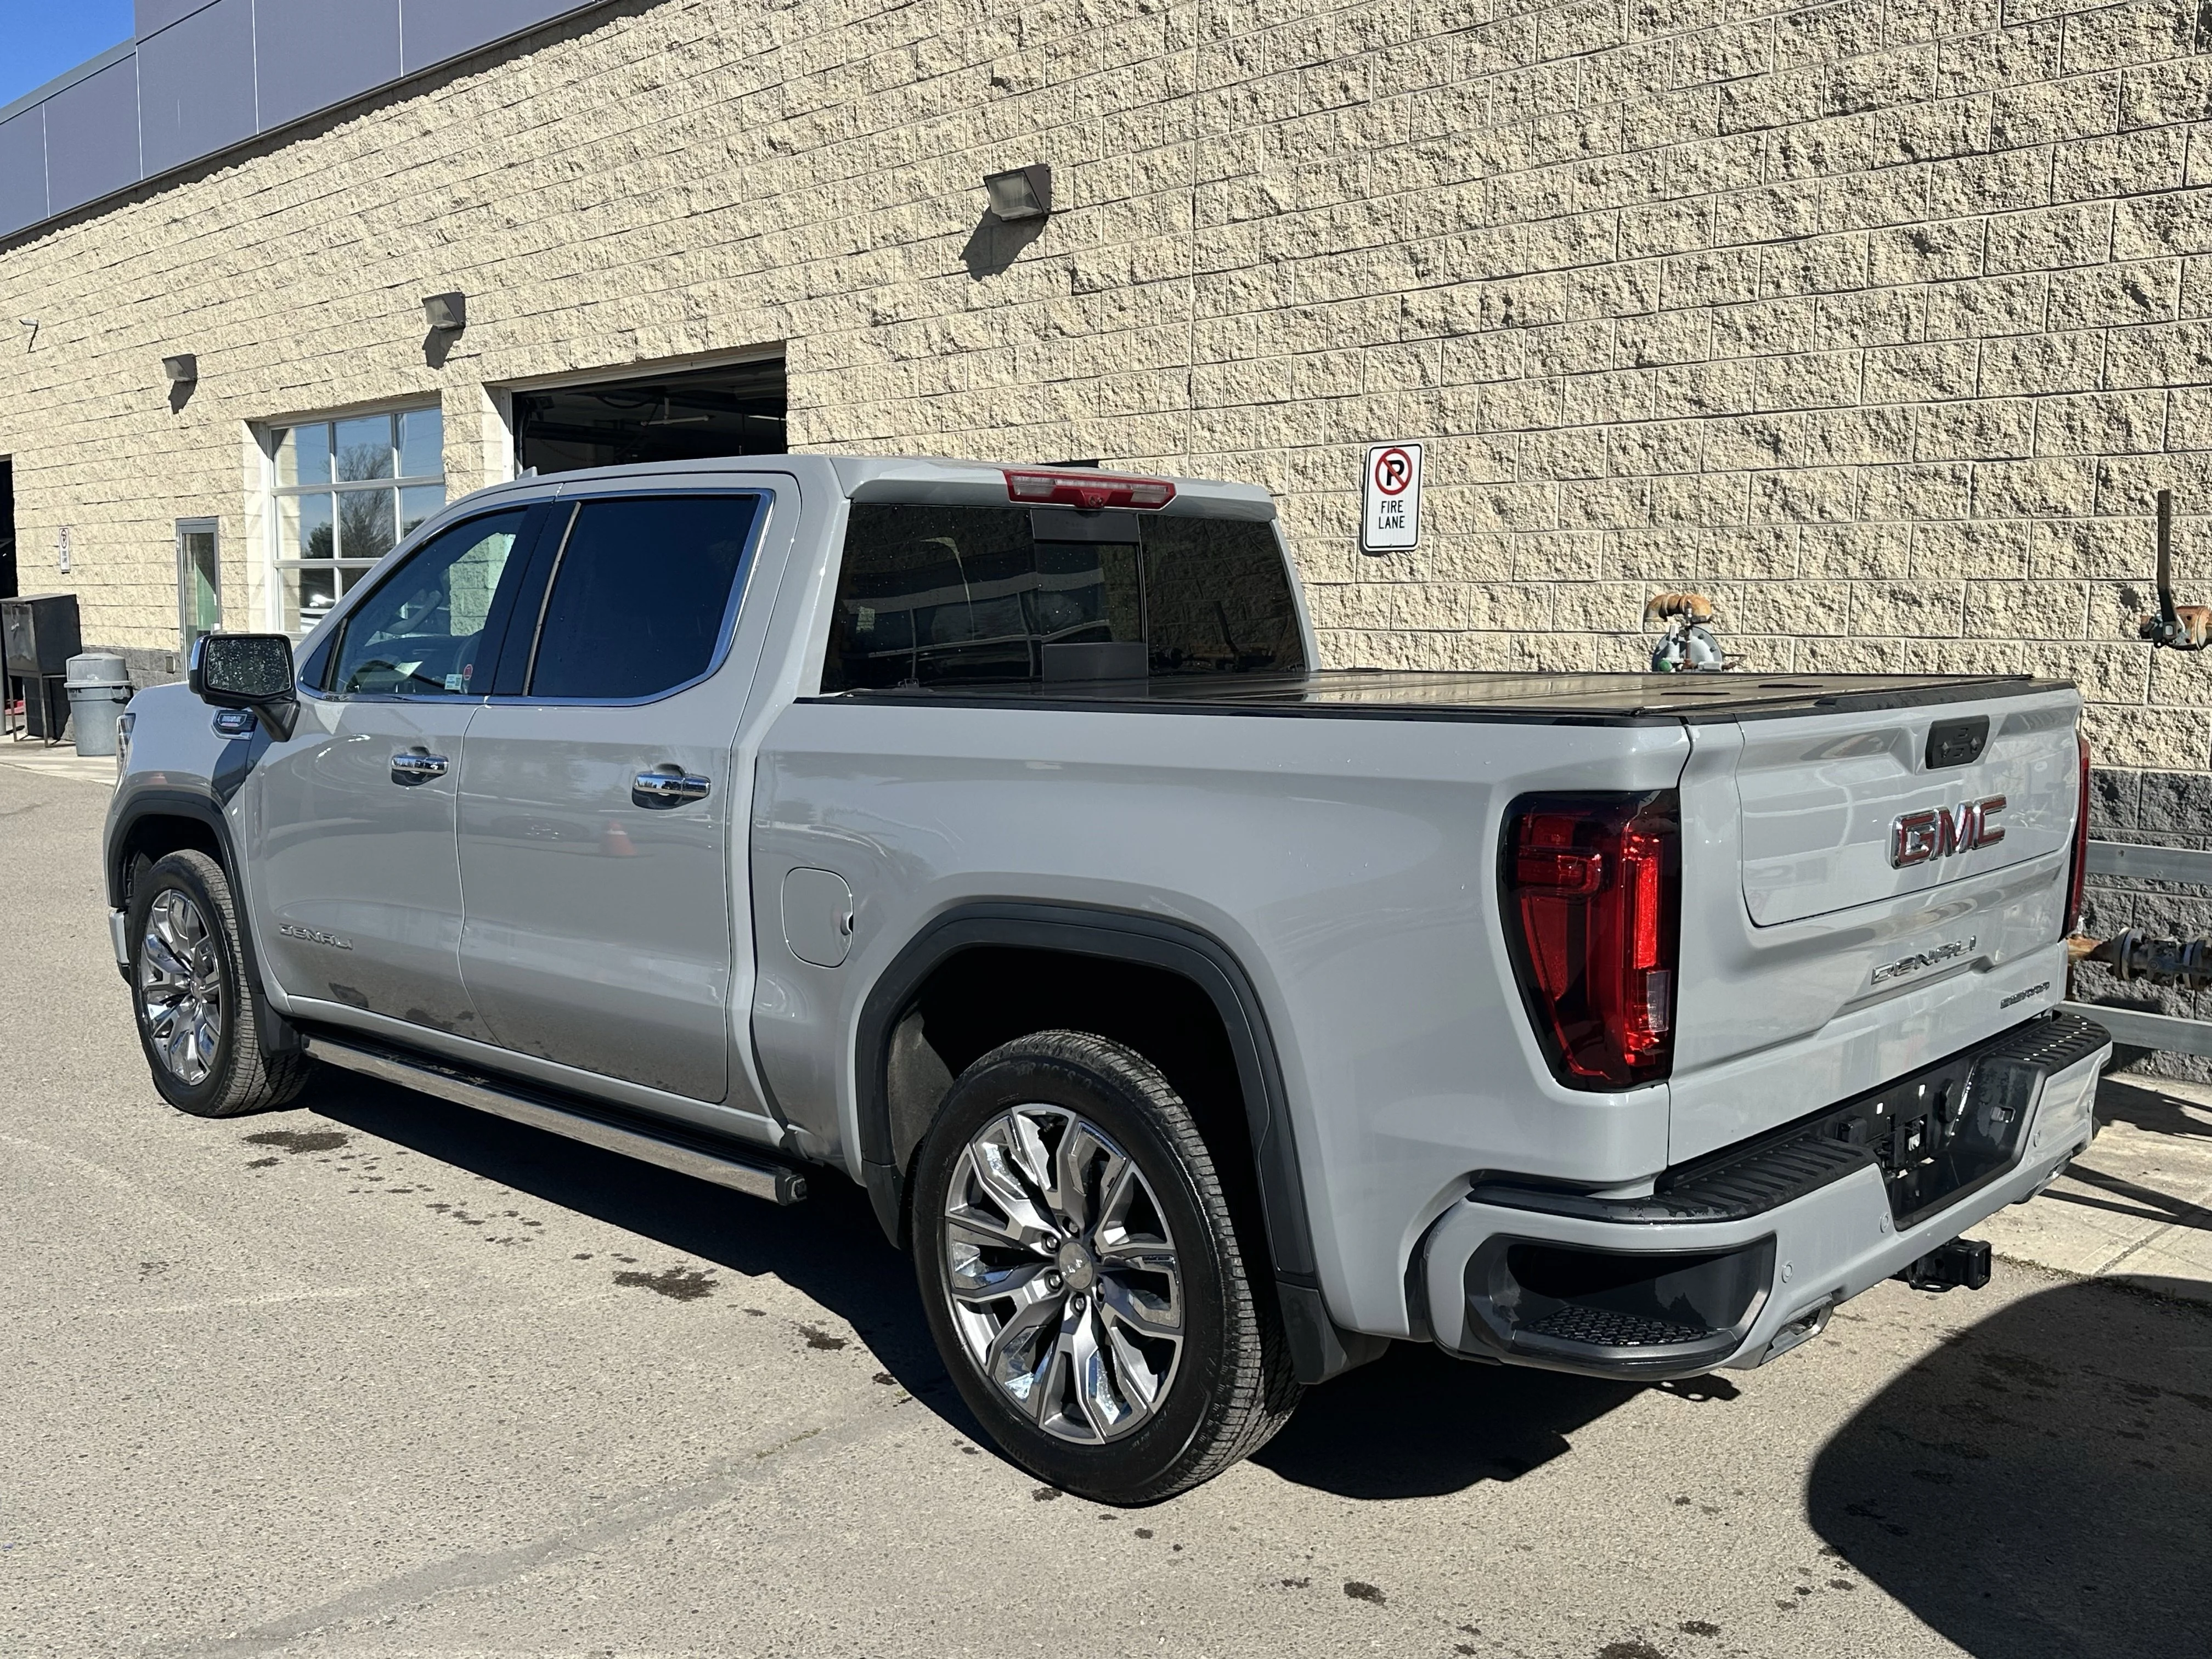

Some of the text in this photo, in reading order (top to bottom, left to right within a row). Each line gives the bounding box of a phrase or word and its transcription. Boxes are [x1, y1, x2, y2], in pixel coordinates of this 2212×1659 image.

[1381, 500, 1404, 514] FIRE
[1379, 515, 1406, 529] LANE
[1891, 794, 2007, 870] GMC
[279, 923, 354, 950] DENALI
[1870, 935, 1976, 985] DENALI
